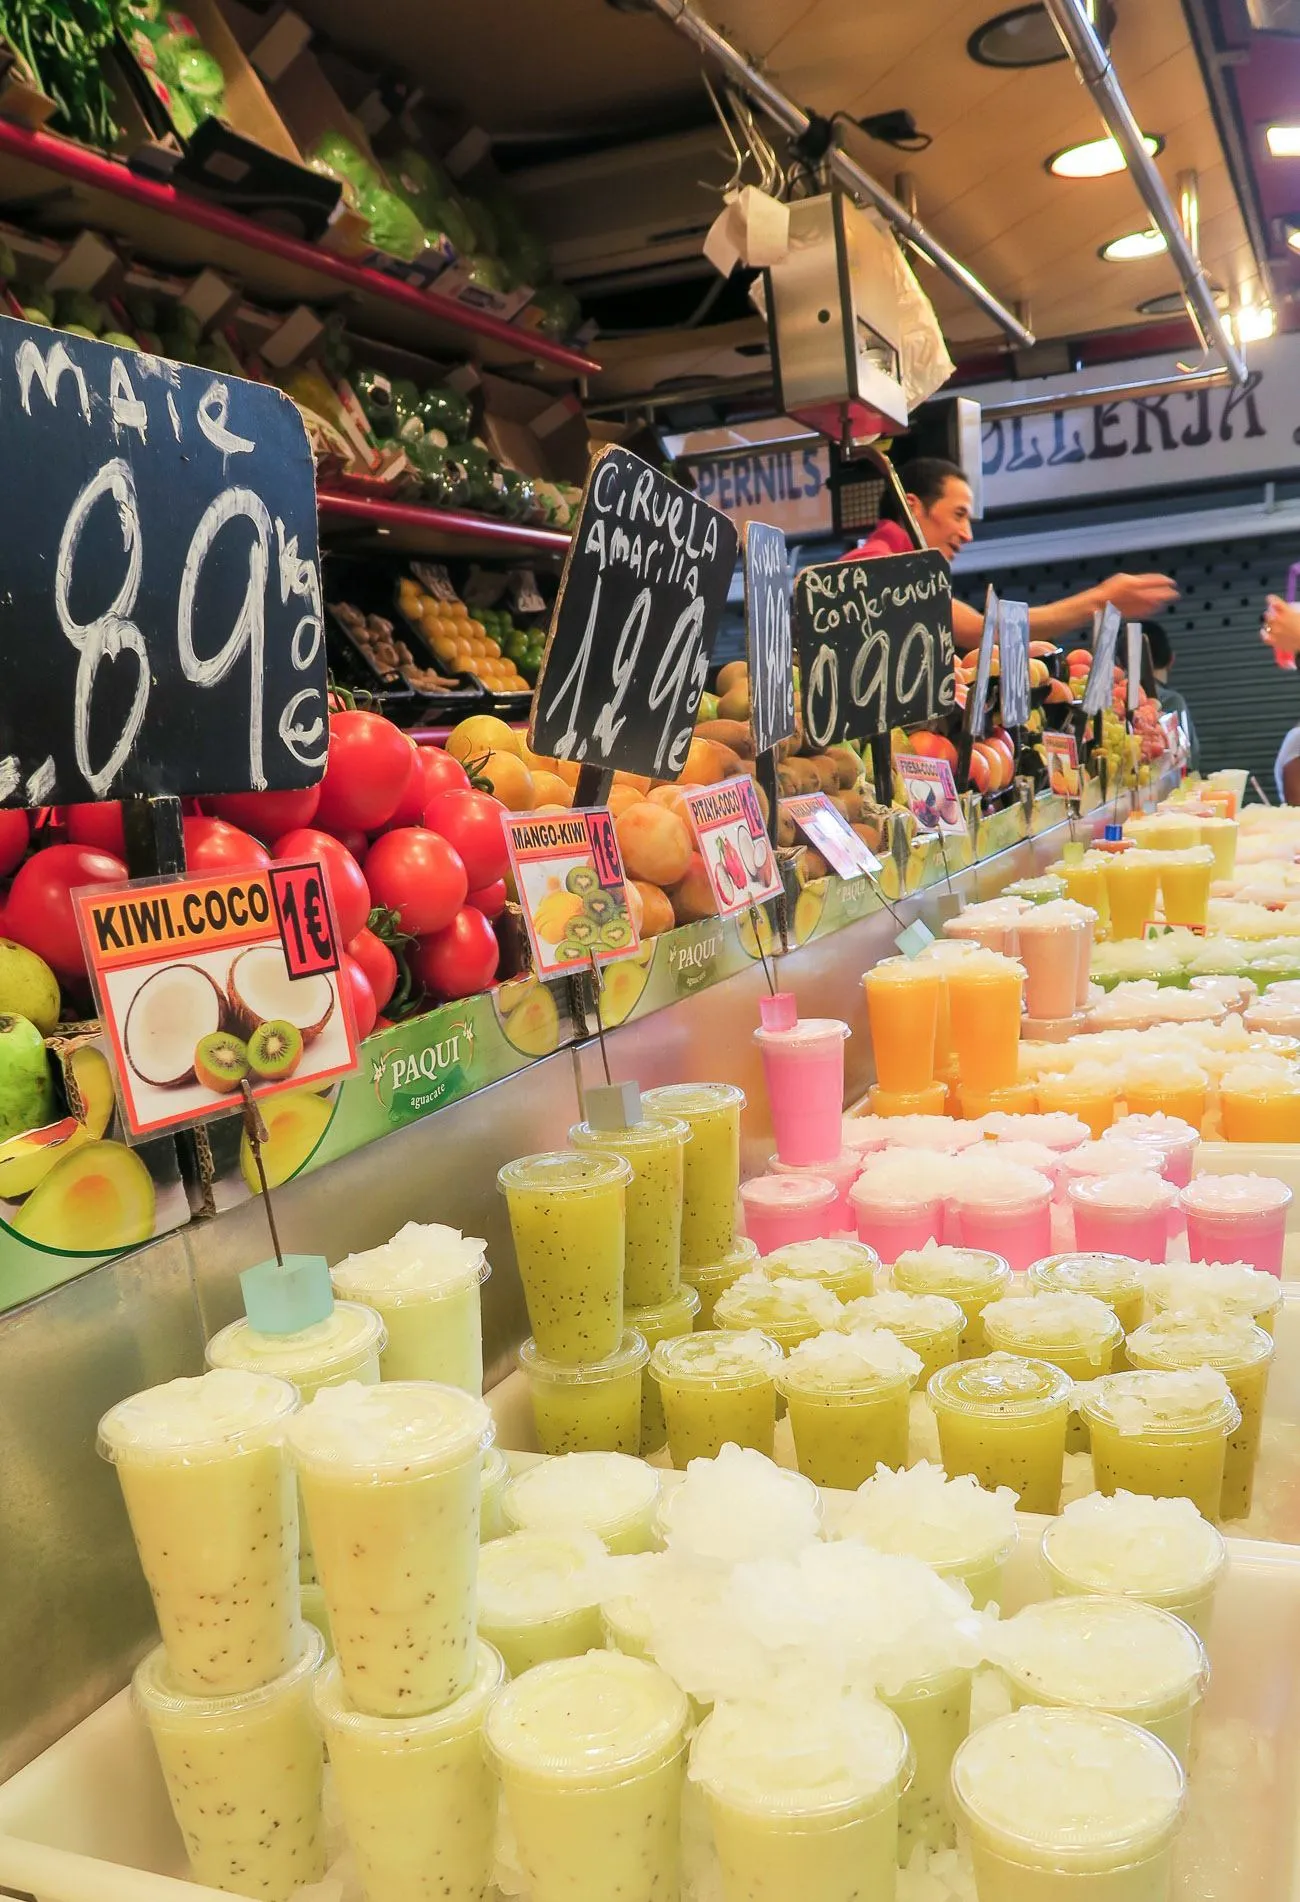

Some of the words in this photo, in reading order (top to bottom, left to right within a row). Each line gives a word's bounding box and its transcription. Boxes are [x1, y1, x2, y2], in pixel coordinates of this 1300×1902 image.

[698, 448, 822, 509] PERNILS
[594, 462, 718, 562] CiRUeLA
[805, 567, 868, 615] perA
[813, 570, 952, 641] ConferenciA
[806, 622, 935, 748] 0,99
[690, 789, 741, 825] PITAYA-COCO
[511, 821, 587, 850] MANGO-KIWI
[592, 820, 620, 880] 1€
[92, 883, 270, 951] KIWI.COCO
[282, 878, 332, 965] 1€
[678, 937, 716, 970] PAQUI
[391, 1035, 460, 1090] PAQUI
[410, 1083, 446, 1110] aguacate
